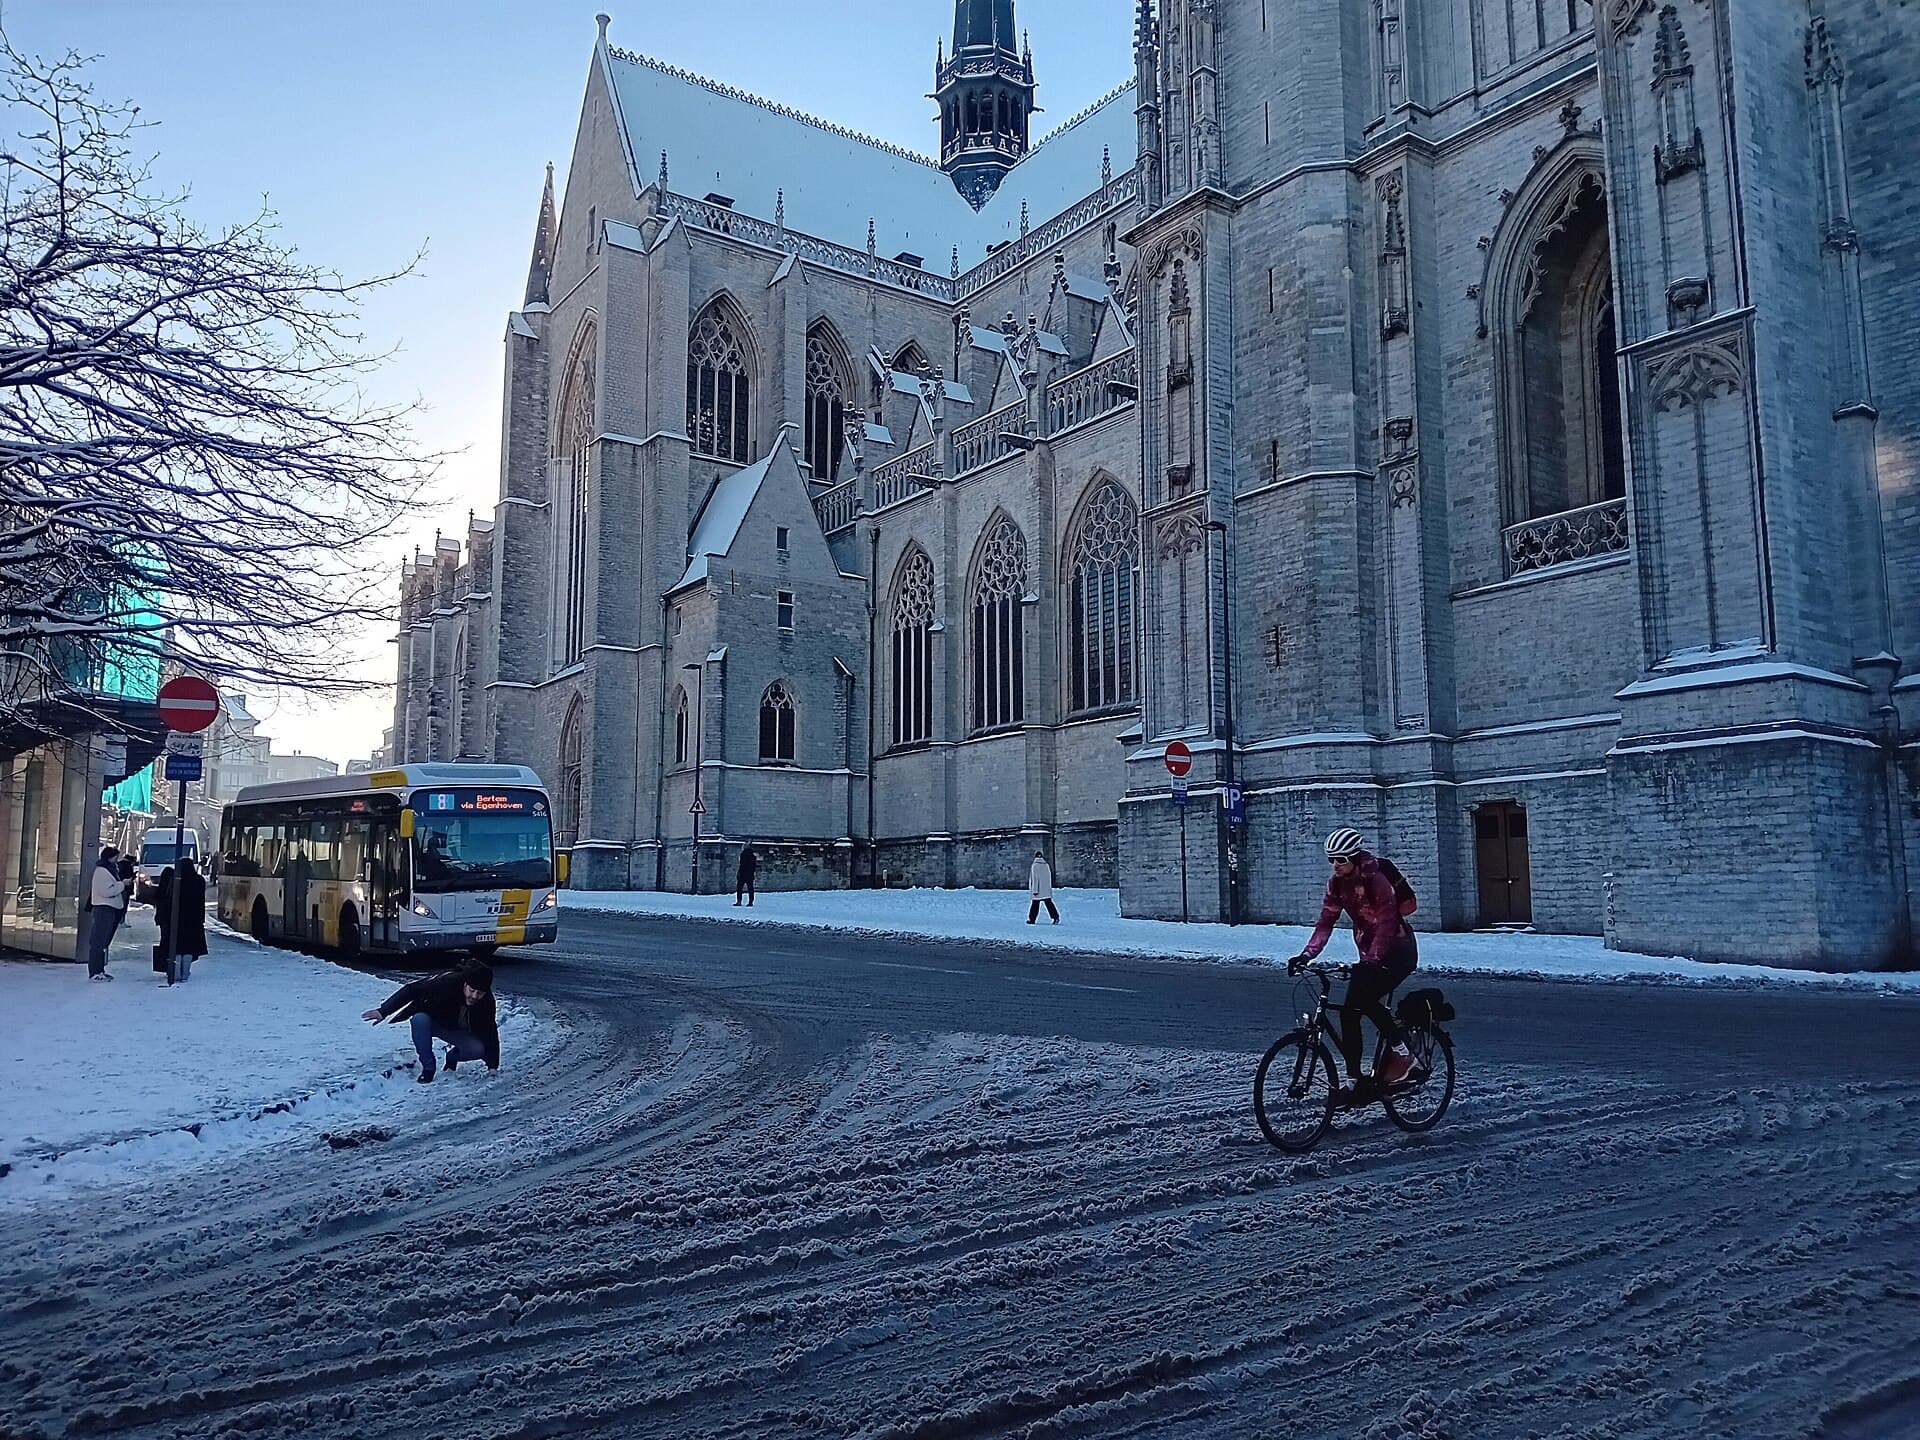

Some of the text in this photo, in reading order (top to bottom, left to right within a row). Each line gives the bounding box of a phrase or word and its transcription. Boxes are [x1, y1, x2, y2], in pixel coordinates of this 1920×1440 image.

[438, 794, 446, 810] 8
[476, 802, 523, 810] Egenhoven
[1230, 789, 1240, 809] P
